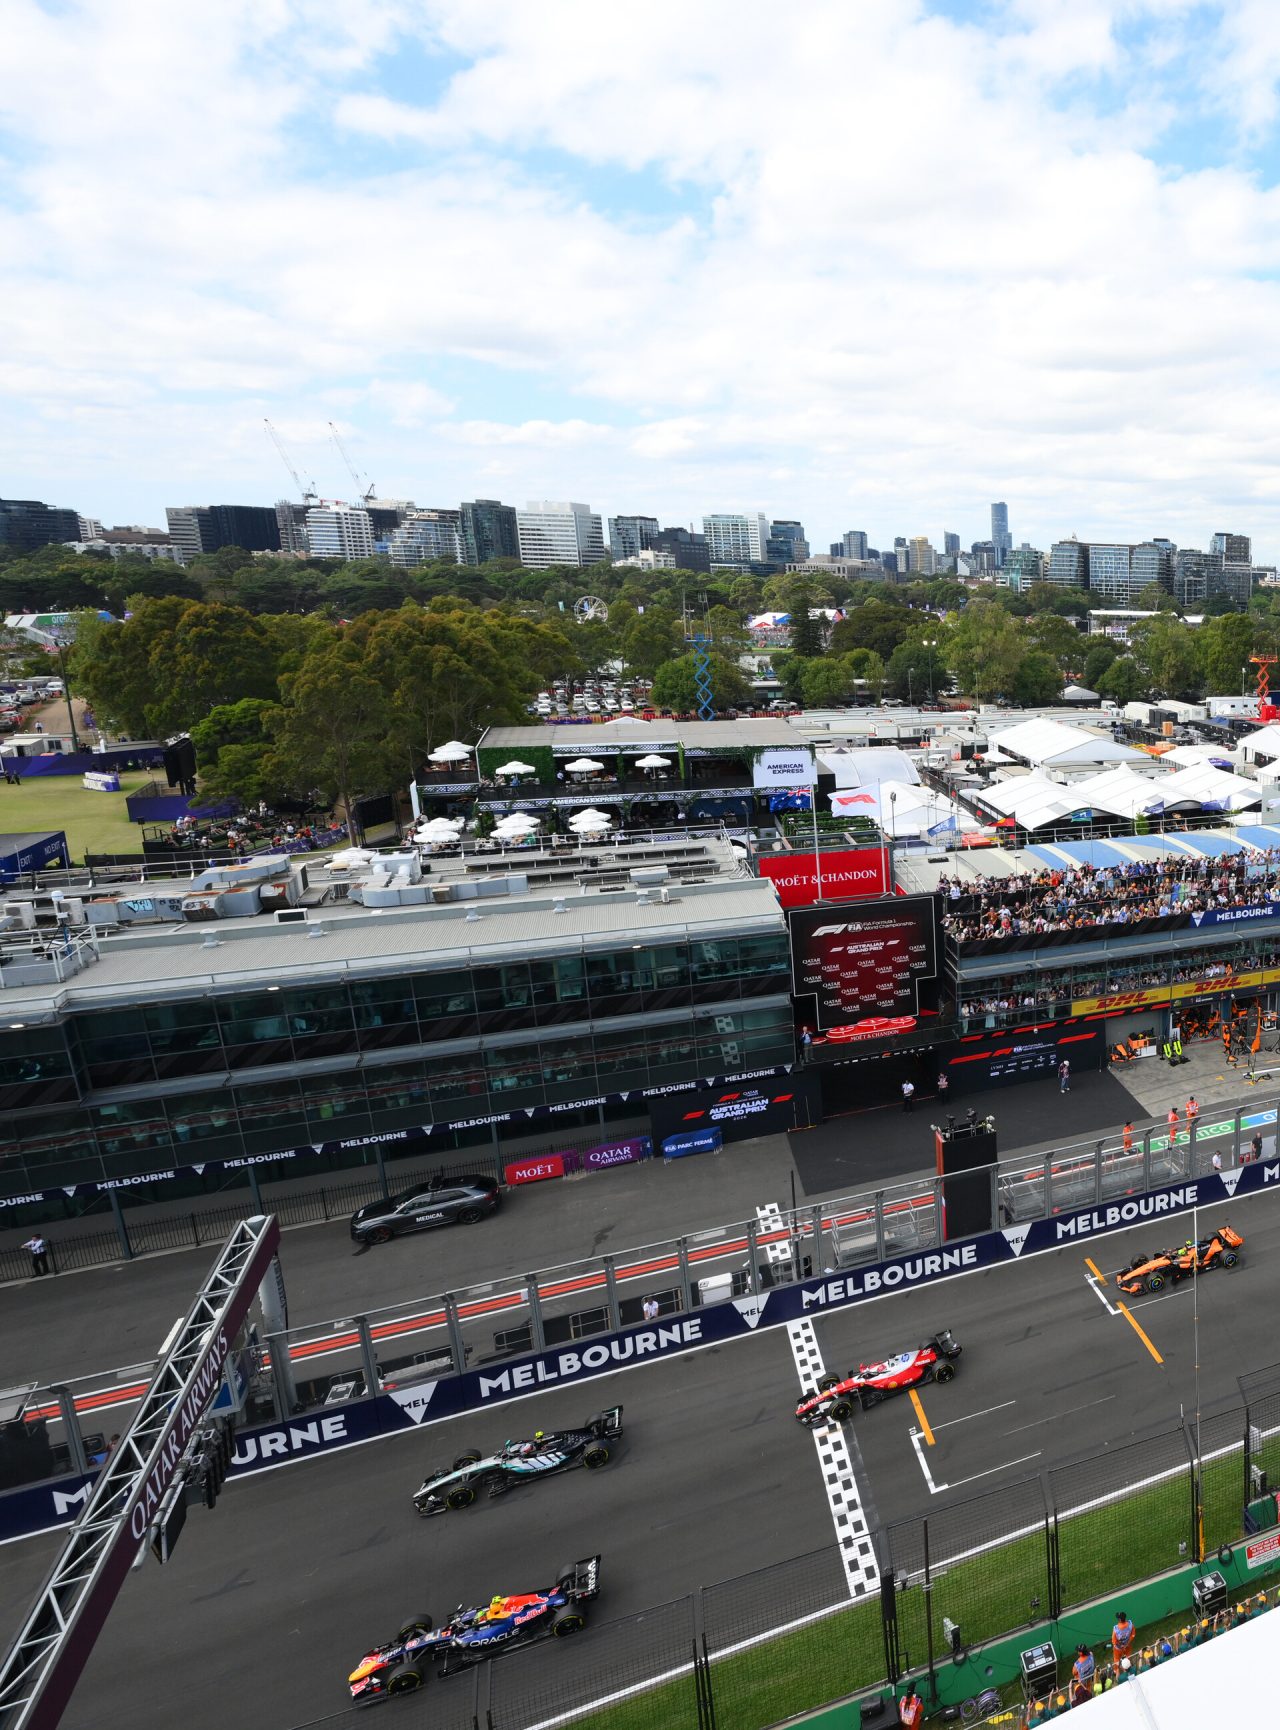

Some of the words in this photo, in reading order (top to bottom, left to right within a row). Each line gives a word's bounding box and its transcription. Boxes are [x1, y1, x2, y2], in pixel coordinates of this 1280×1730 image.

[552, 798, 589, 806] AMERICAN
[774, 875, 808, 887] MOËT
[821, 869, 877, 883] CHANDON
[1216, 906, 1273, 922] MELBOURNE
[1194, 976, 1243, 992] DHL
[1096, 992, 1150, 1009] DHL
[872, 1030, 899, 1038] CHANDON
[724, 1068, 776, 1082] MELBOURNE
[642, 1082, 696, 1096] MELBOURNE
[549, 1097, 607, 1113] MELBOURNE
[709, 1099, 769, 1115] AUSTRALIAN
[711, 1109, 744, 1120] GRAND
[746, 1105, 767, 1114] PRIX
[448, 1113, 511, 1130] MELBOURNE
[340, 1131, 407, 1149] MELBOURNE
[223, 1150, 296, 1169] MELBOURNE
[589, 1145, 631, 1162] QATAR
[600, 1154, 633, 1165] AIRWAYS
[515, 1163, 554, 1180] MOËT
[97, 1170, 175, 1190] MELBOURNE
[1224, 1179, 1238, 1187] MEL
[415, 1212, 444, 1222] MEDICAL
[1056, 1185, 1198, 1239] MELBOURNE
[1007, 1235, 1026, 1245] MEL
[801, 1244, 977, 1310] MELBOURNE
[740, 1306, 763, 1317] MEL
[479, 1317, 702, 1398] MELBOURNE
[400, 1397, 430, 1410] MEL
[131, 1428, 182, 1540] QATAR
[181, 1326, 228, 1442] AIRWAYS
[470, 1628, 520, 1648] ORACLE
